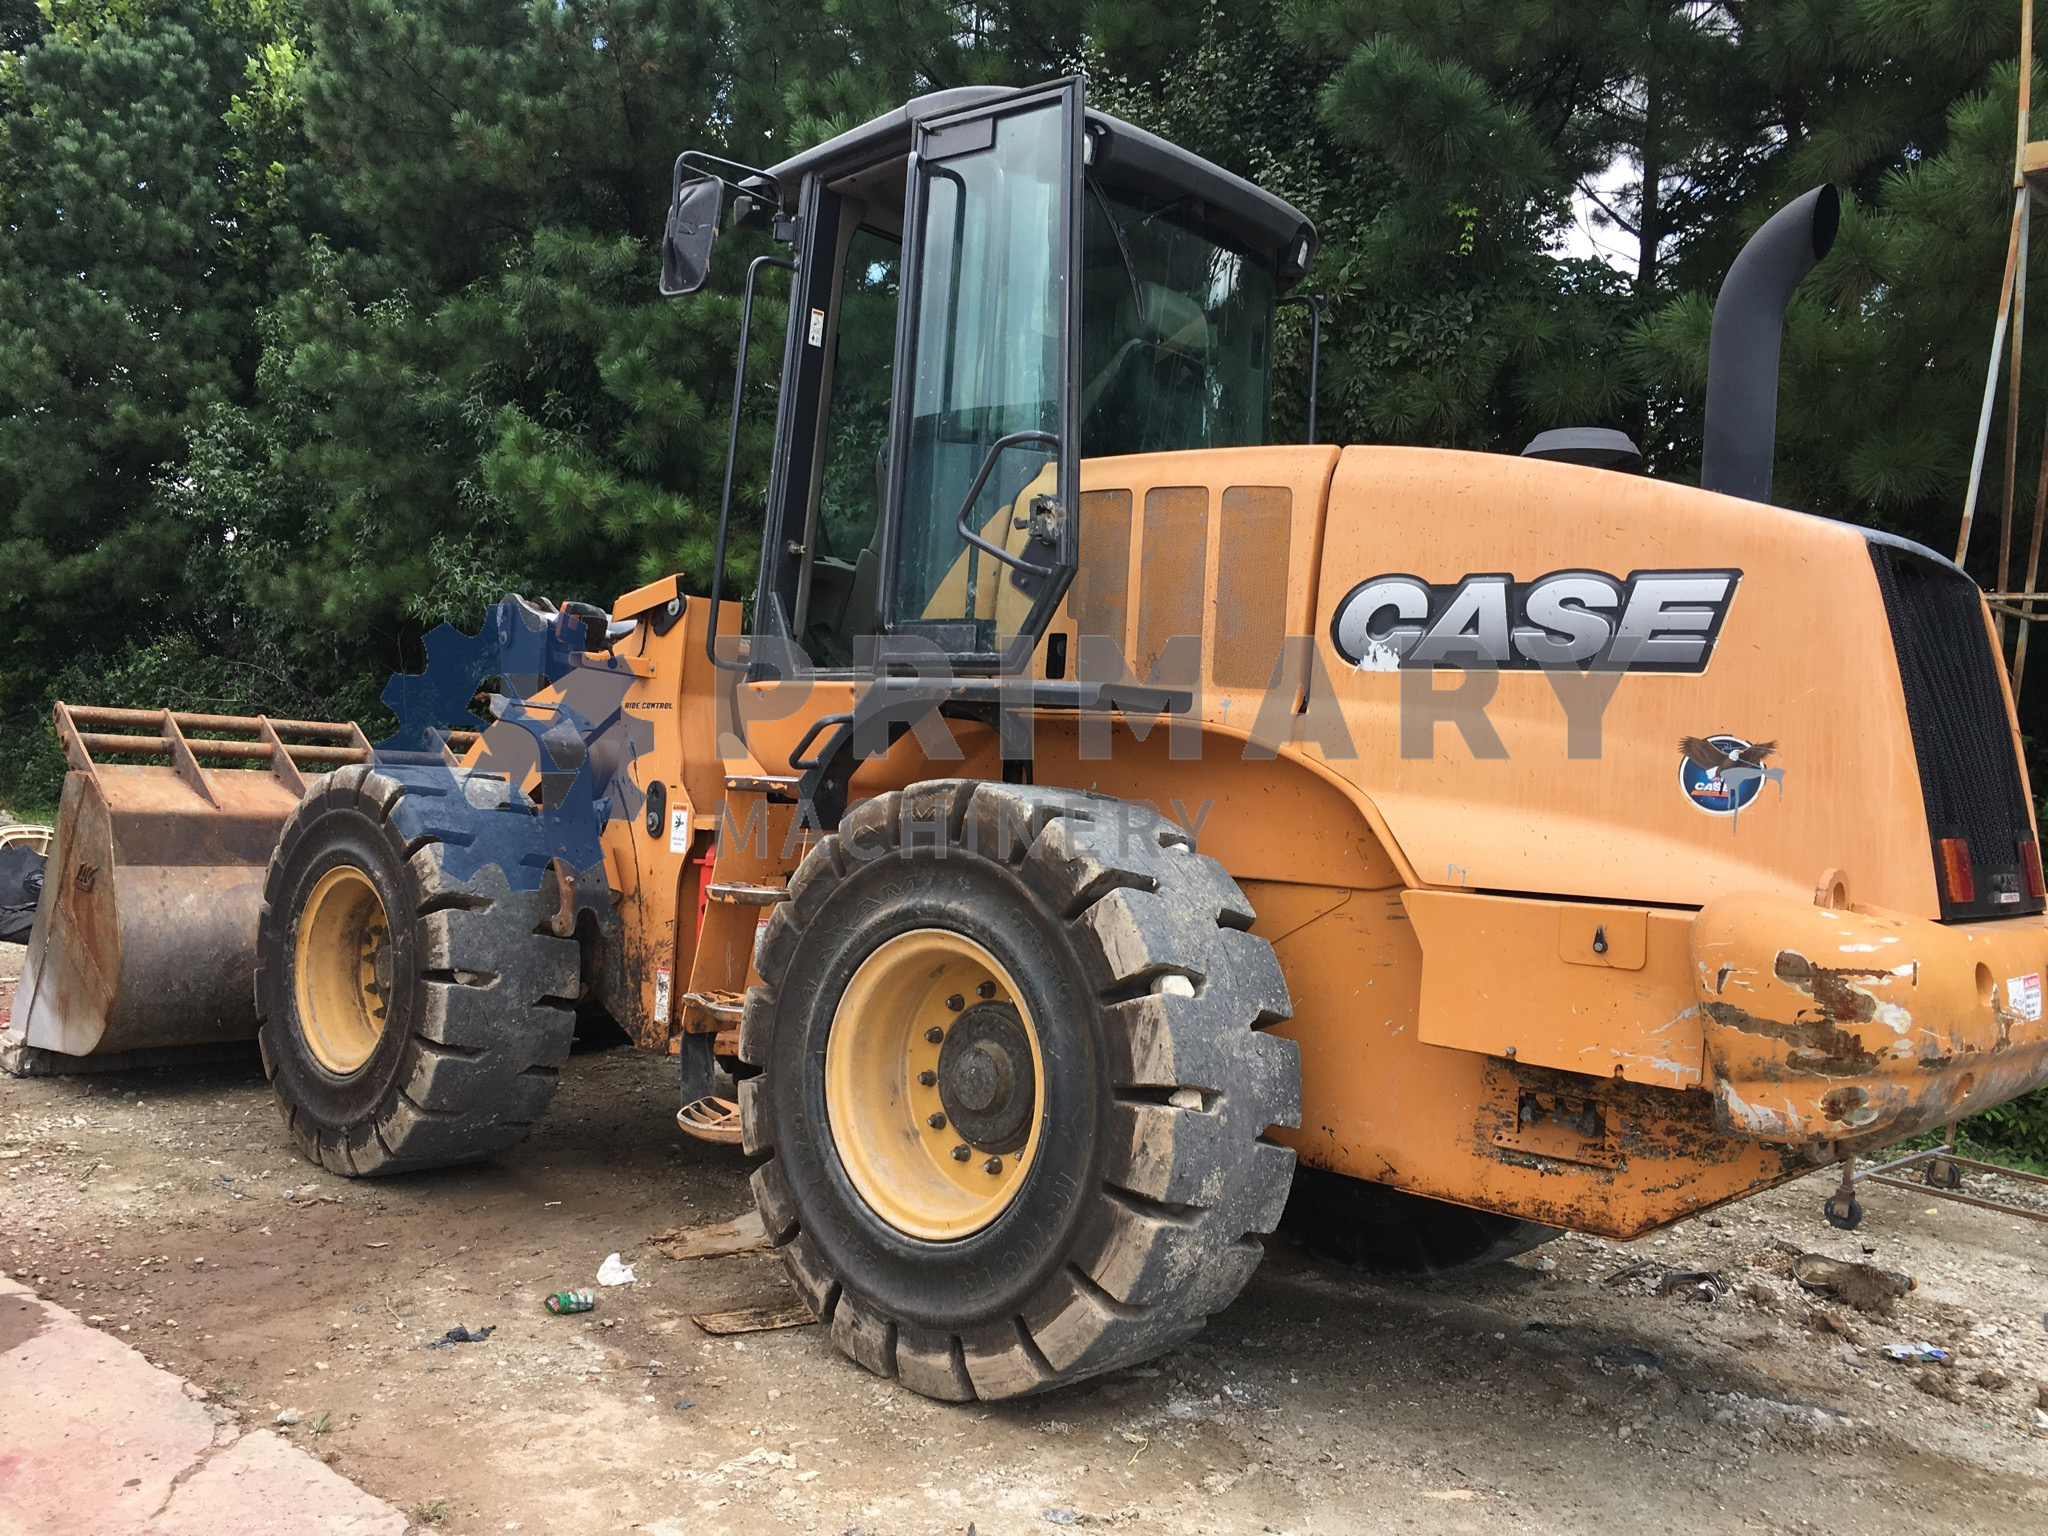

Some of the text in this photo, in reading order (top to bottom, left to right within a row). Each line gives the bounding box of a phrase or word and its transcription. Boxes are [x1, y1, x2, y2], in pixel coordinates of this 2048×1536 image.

[1336, 576, 1732, 664] CASE
[624, 702, 673, 710] RIDE CONTROL
